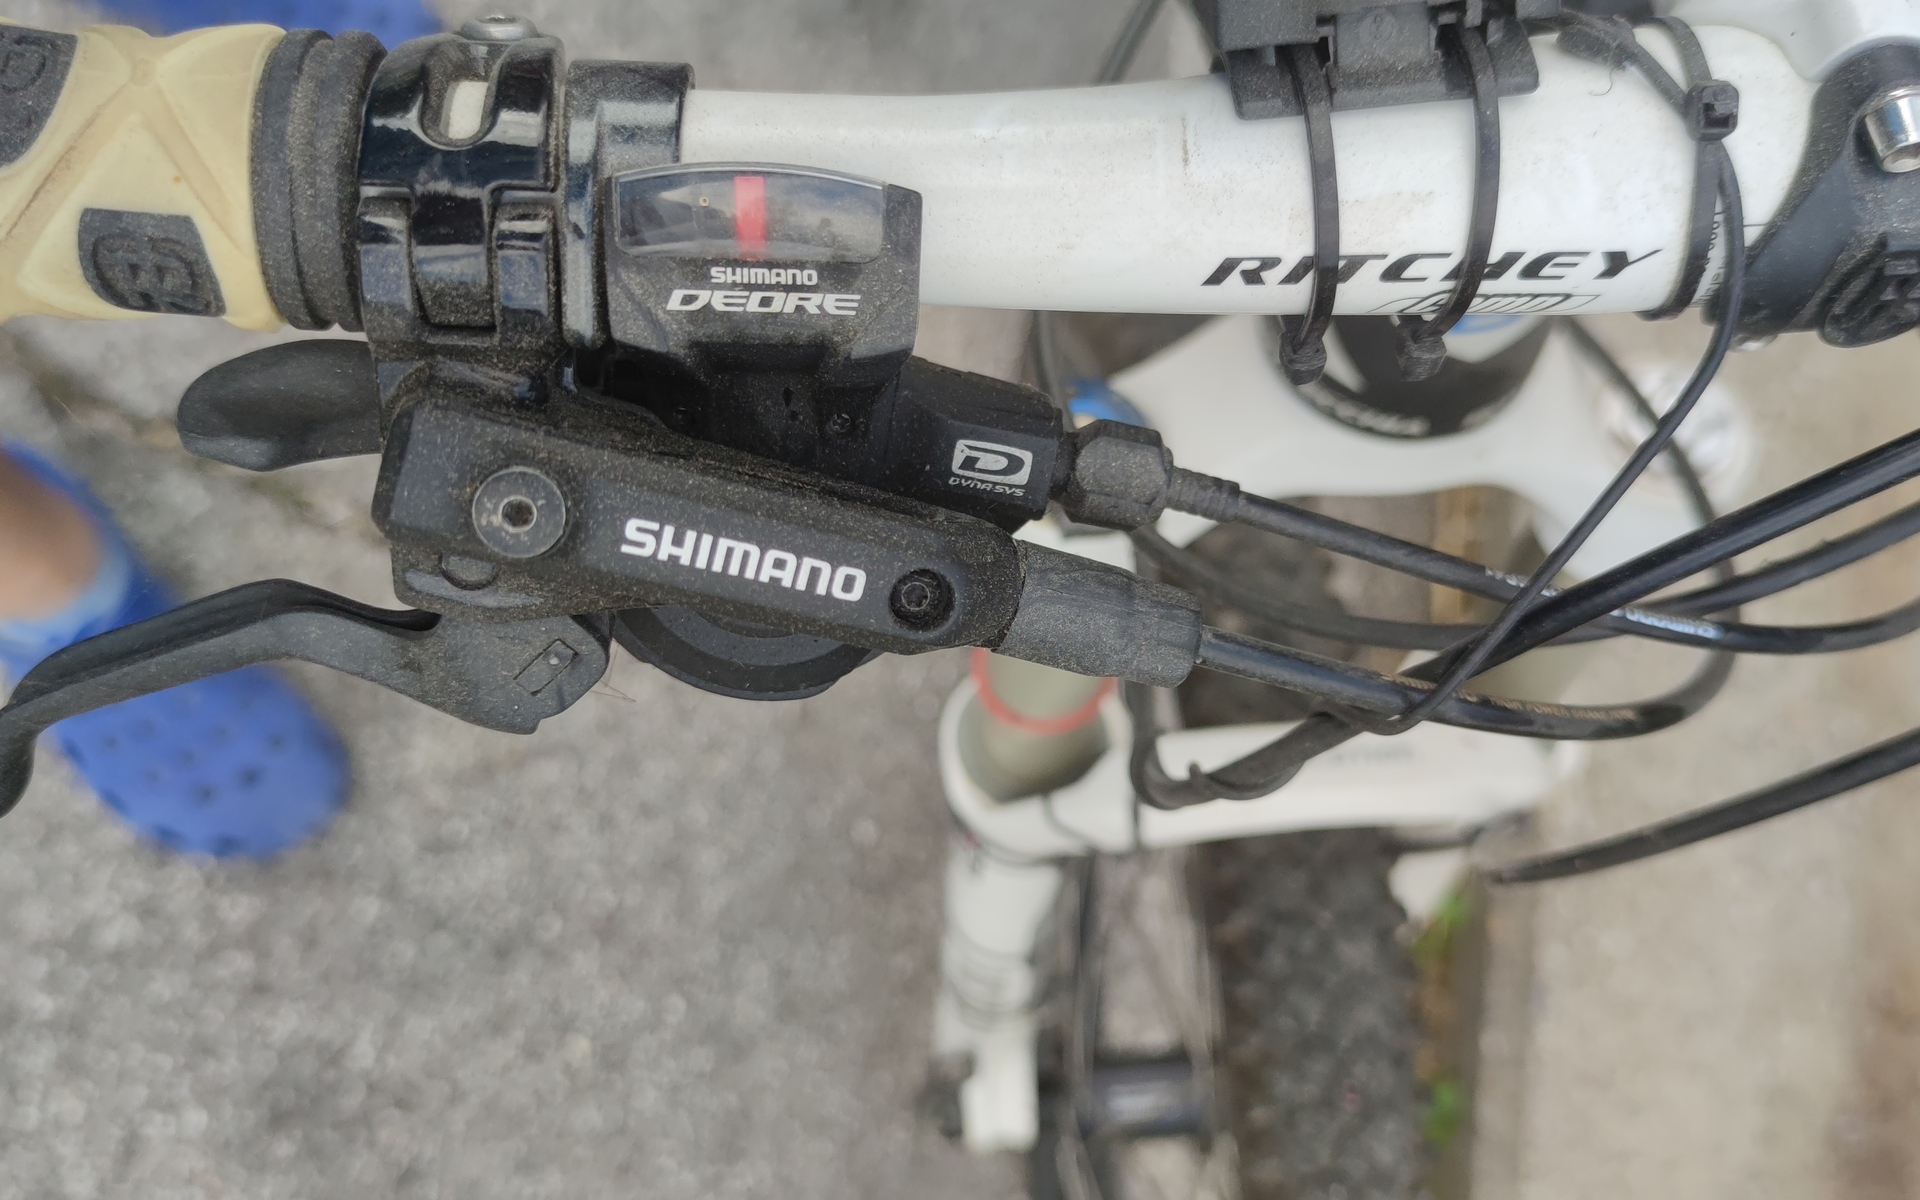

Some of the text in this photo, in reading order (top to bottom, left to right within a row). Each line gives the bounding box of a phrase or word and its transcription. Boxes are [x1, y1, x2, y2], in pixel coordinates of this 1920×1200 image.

[710, 267, 818, 286] SHIMANO
[1200, 249, 1664, 286] RITCHEY
[666, 289, 862, 316] DEORE
[620, 518, 867, 602] SHIMANO
